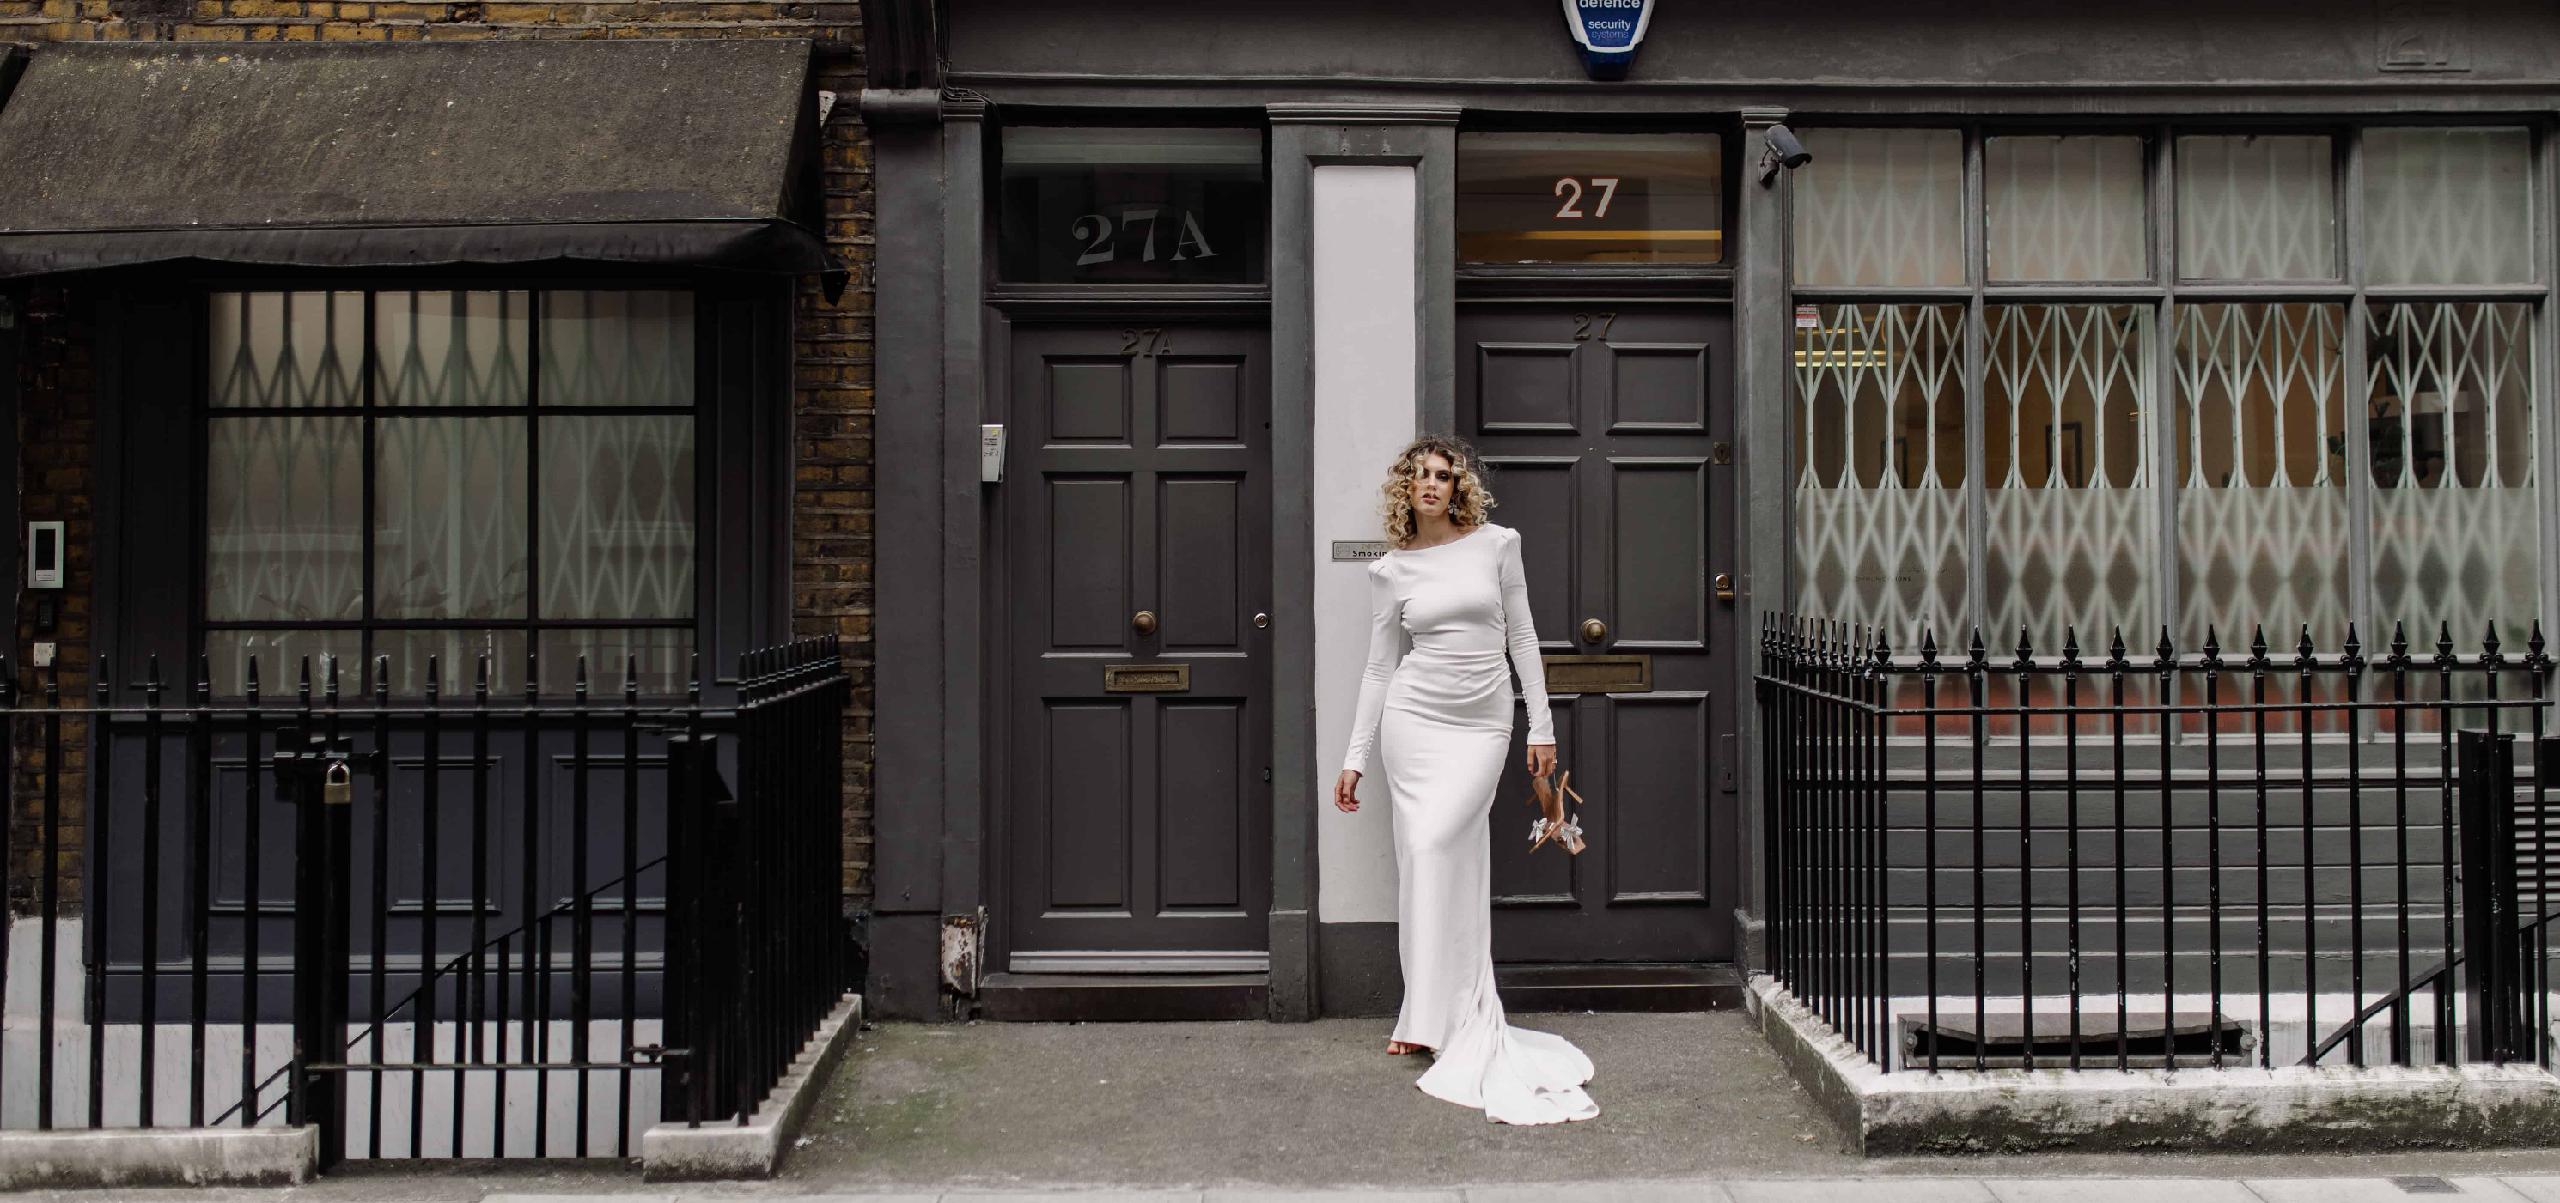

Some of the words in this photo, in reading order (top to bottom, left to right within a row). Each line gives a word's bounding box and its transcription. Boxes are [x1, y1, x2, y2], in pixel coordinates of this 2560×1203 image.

[1580, 0, 1640, 8] defence
[1588, 19, 1631, 31] security
[1554, 177, 1619, 218] 27
[1072, 209, 1219, 266] 27A
[1574, 312, 1617, 341] 27
[1121, 327, 1175, 357] 27A
